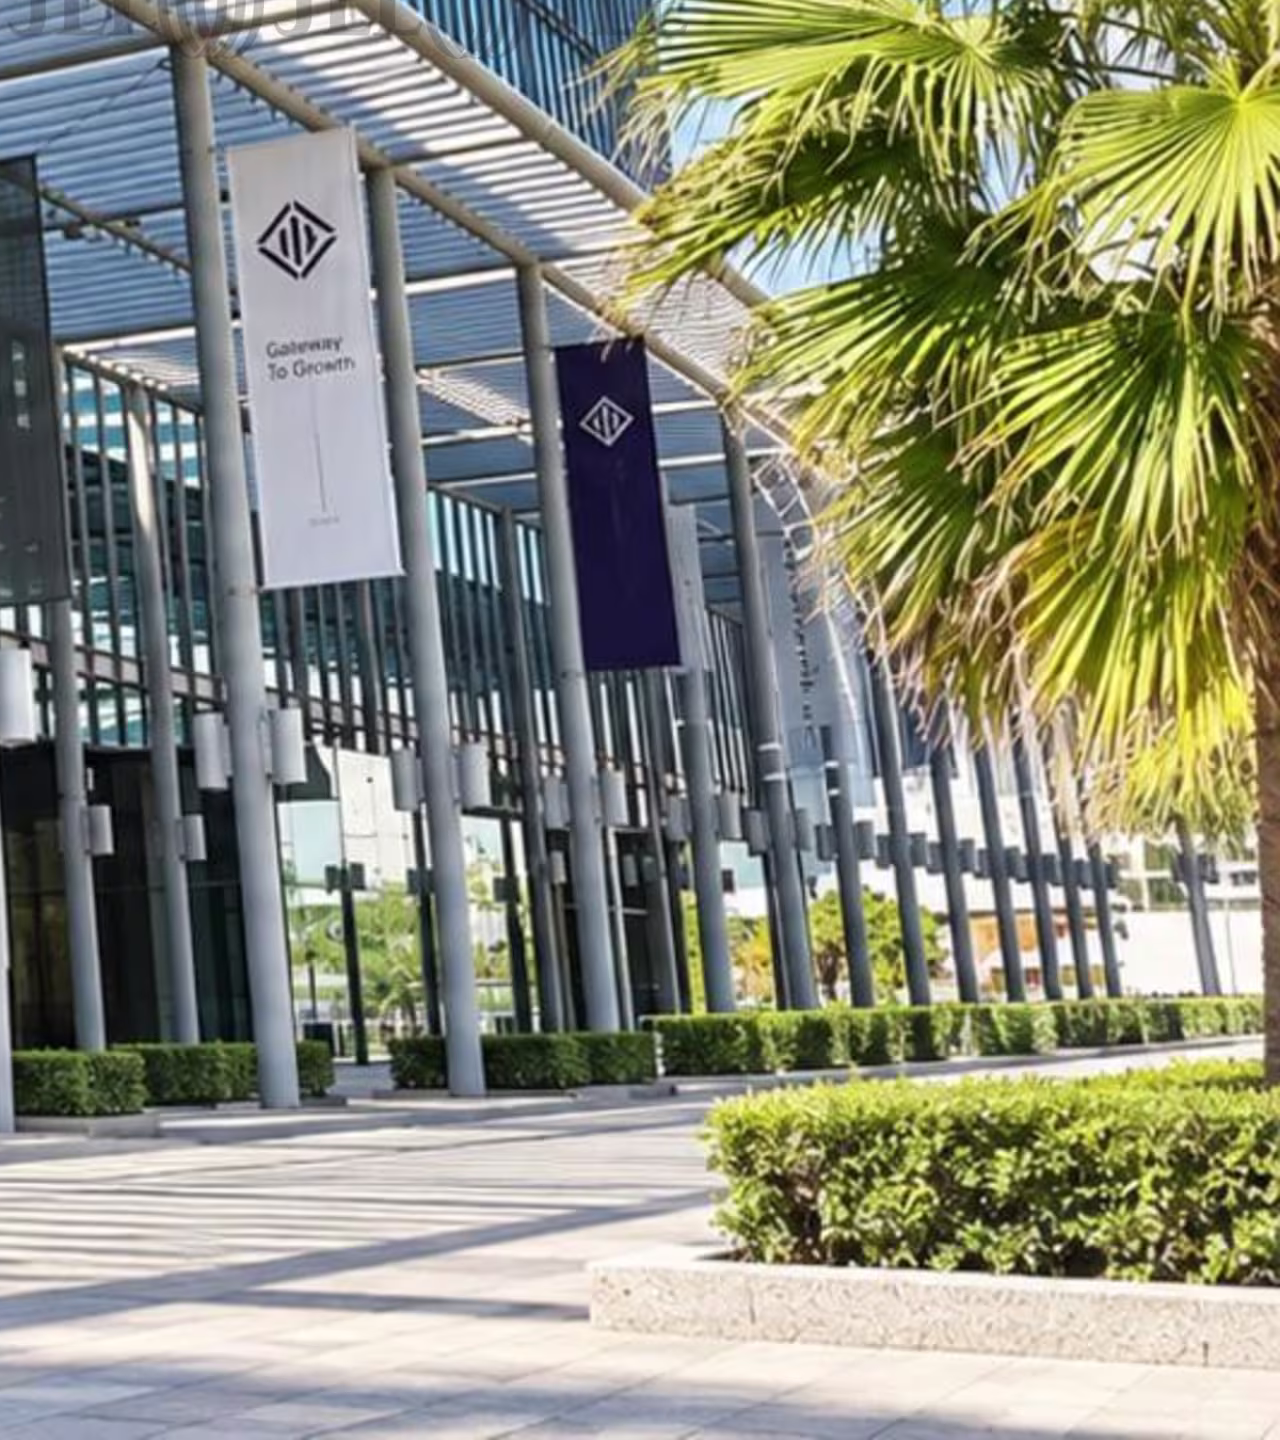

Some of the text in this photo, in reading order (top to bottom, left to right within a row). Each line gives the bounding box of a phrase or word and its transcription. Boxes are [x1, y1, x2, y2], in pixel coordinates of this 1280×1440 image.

[265, 336, 343, 359] Gateway
[267, 357, 356, 381] To Growth
